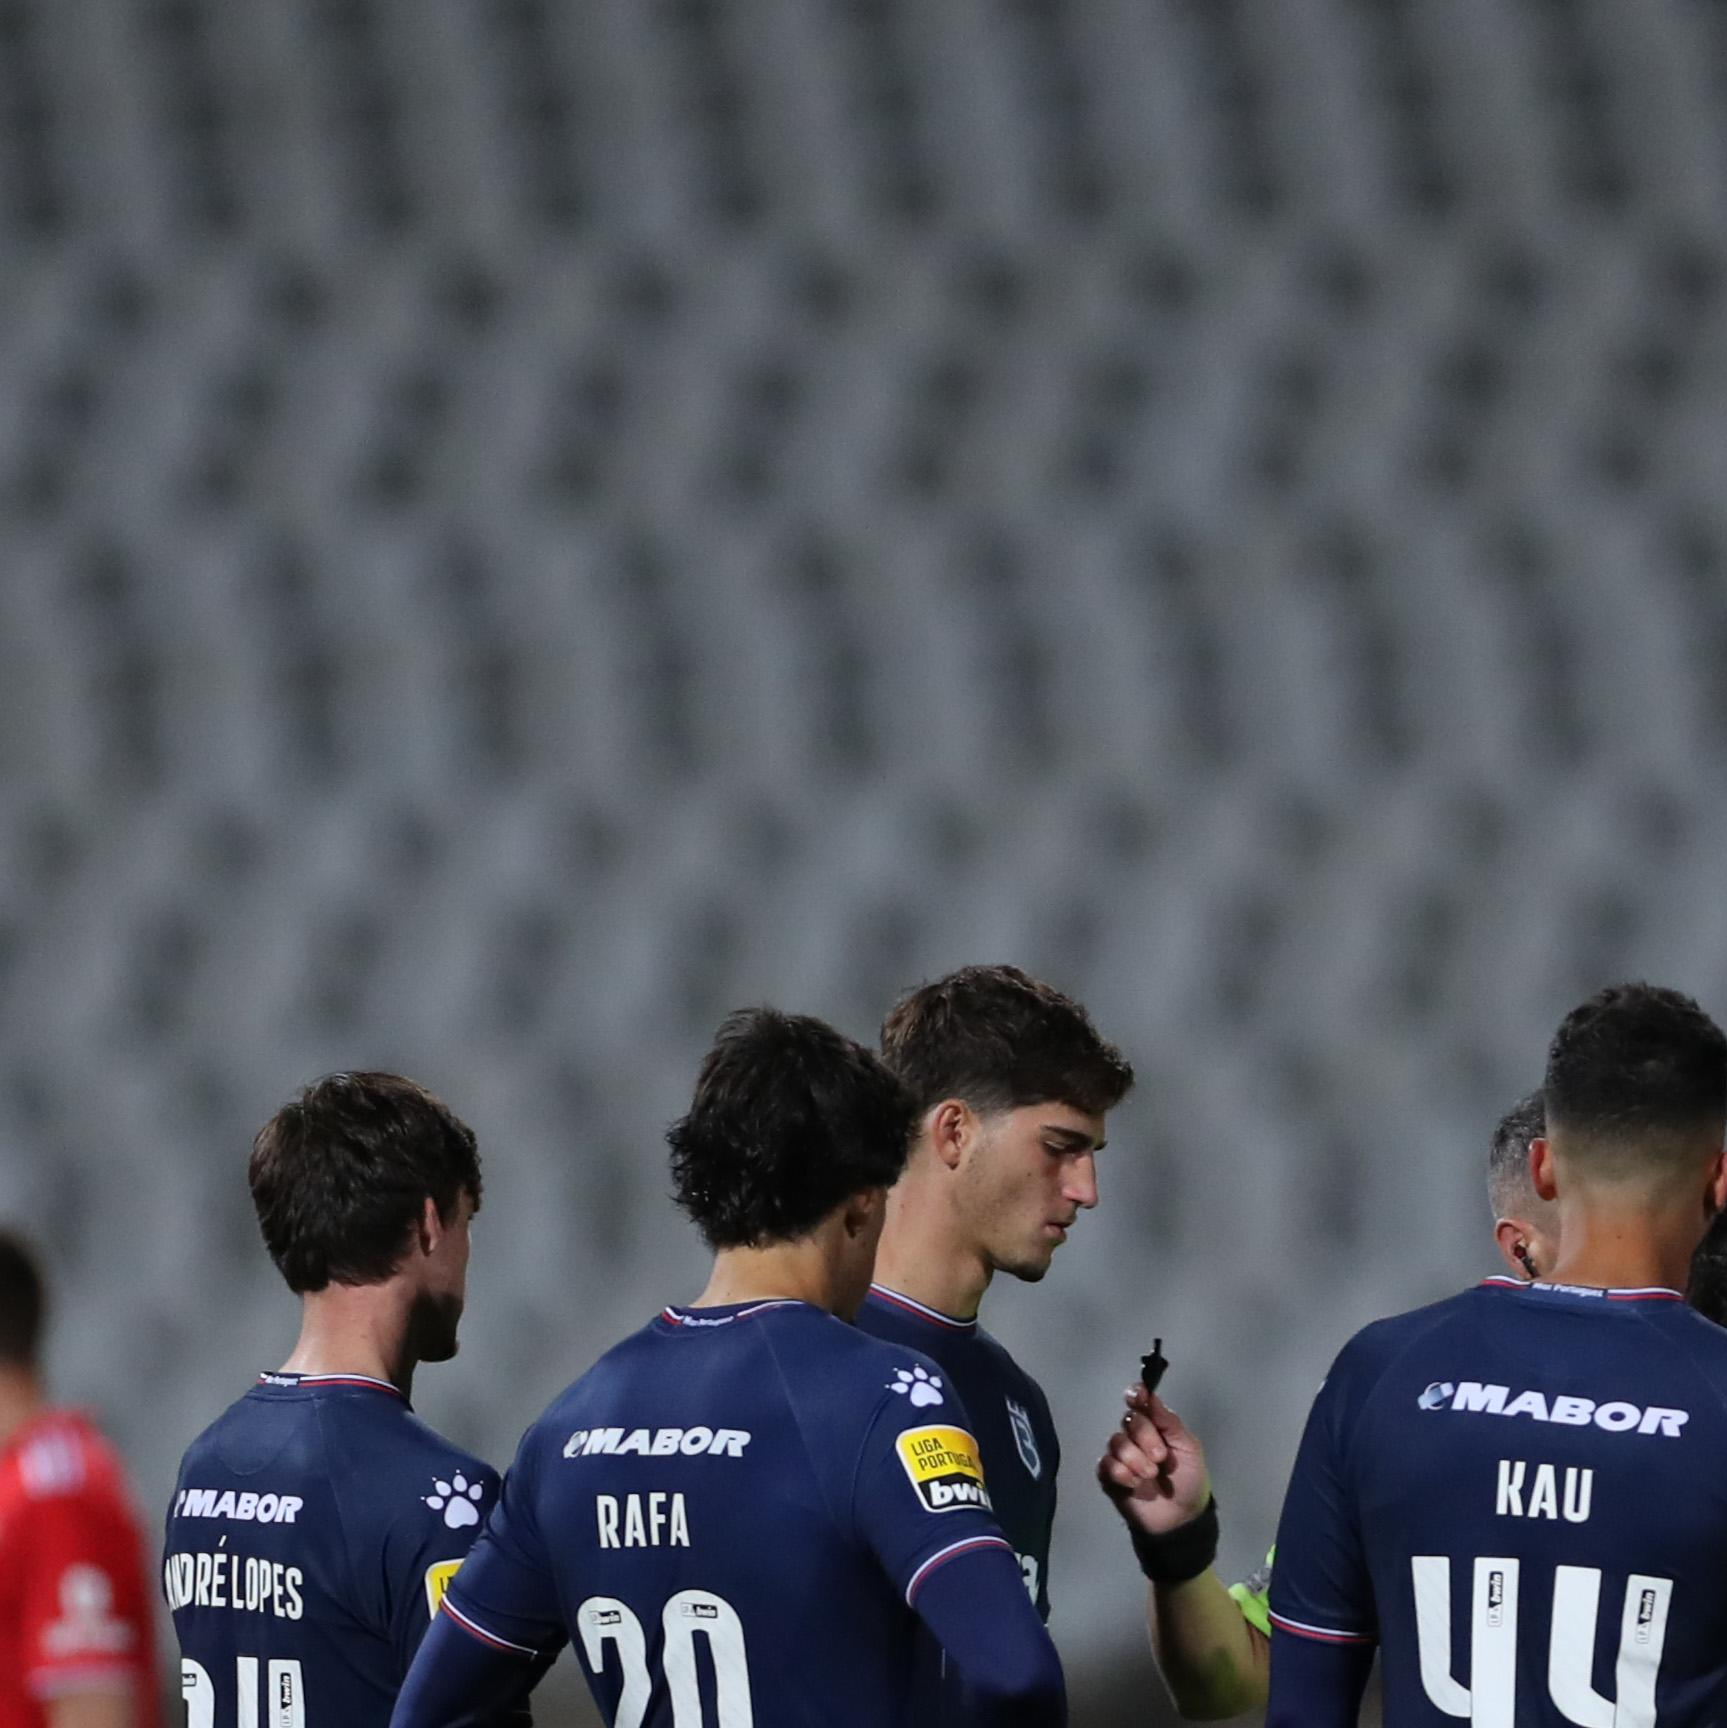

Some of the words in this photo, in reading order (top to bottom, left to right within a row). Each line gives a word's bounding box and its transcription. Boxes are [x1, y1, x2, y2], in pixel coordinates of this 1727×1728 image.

[1451, 1381, 1689, 1437] MABOR
[582, 1426, 752, 1458] MABOR
[910, 1437, 944, 1456] LIGA
[918, 1455, 978, 1472] PORTUGA
[182, 1488, 304, 1524] MABOR
[929, 1480, 992, 1507] bwi
[1496, 1459, 1593, 1523] KAU
[596, 1491, 691, 1549] RAFA
[232, 1554, 304, 1621] LOPES
